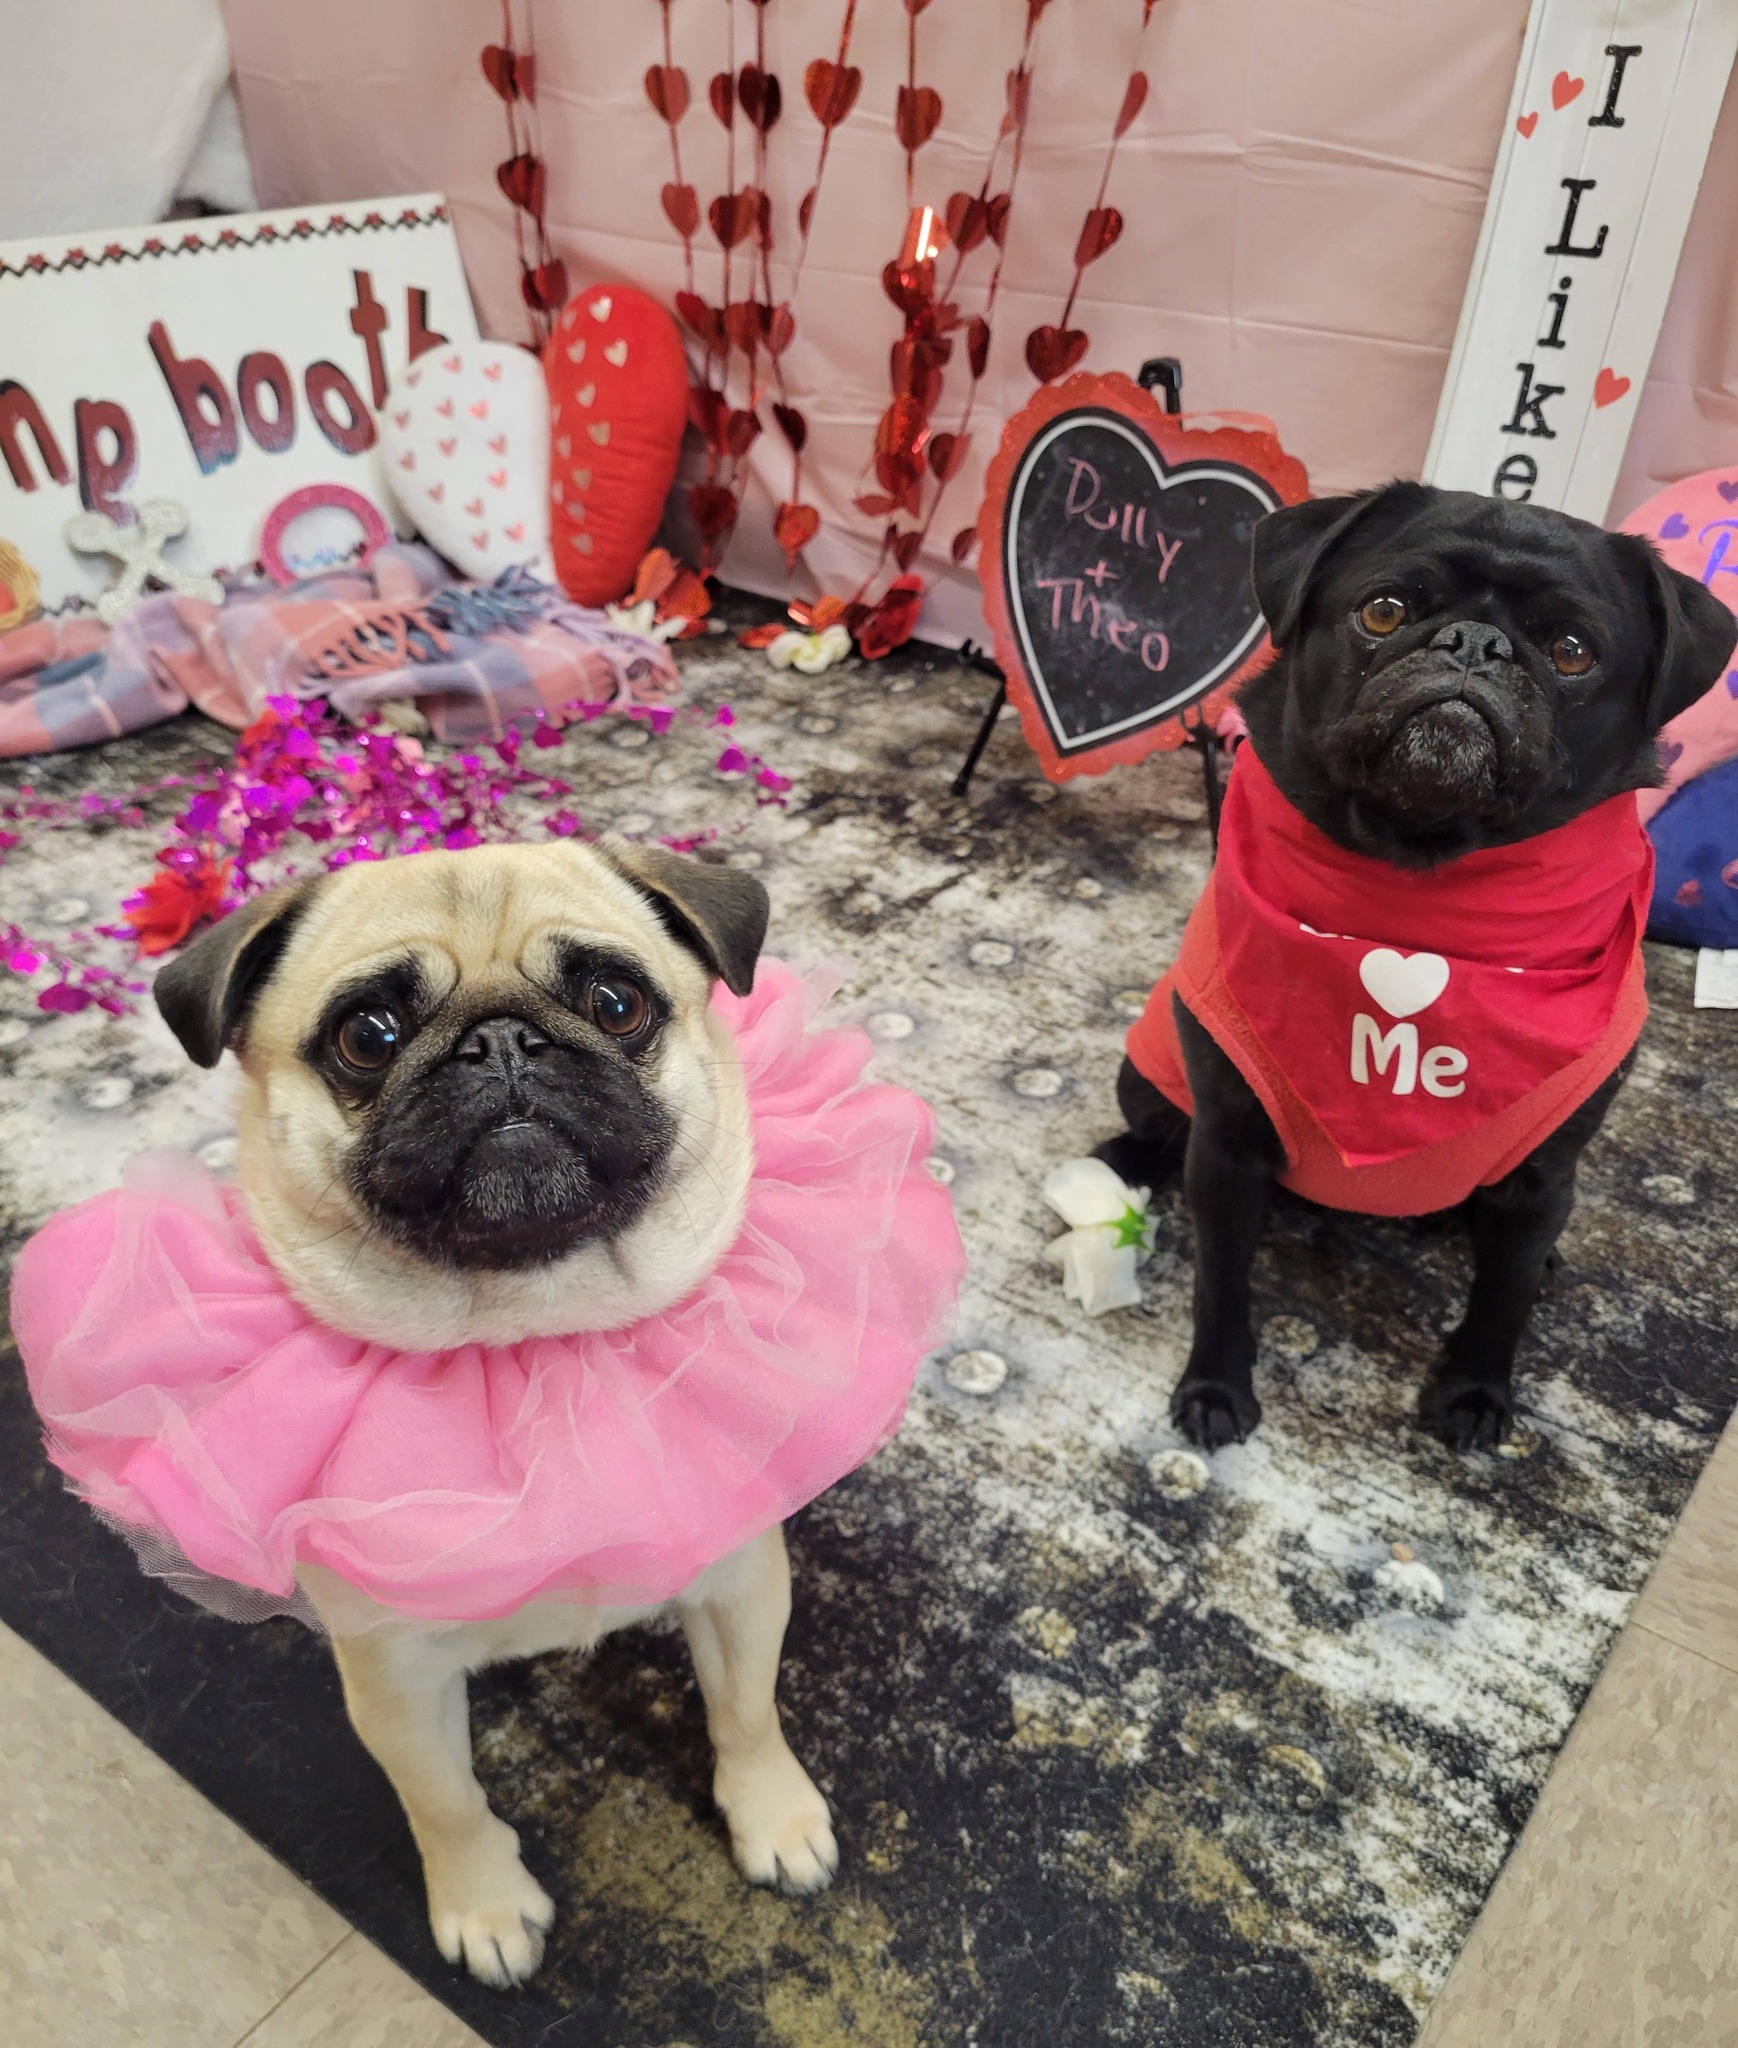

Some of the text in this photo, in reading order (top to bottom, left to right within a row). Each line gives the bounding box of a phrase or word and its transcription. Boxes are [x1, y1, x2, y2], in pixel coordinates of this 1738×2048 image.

[1493, 44, 1643, 502] I Like
[1036, 576, 1170, 672] Theo
[1350, 1012, 1469, 1099] Me
